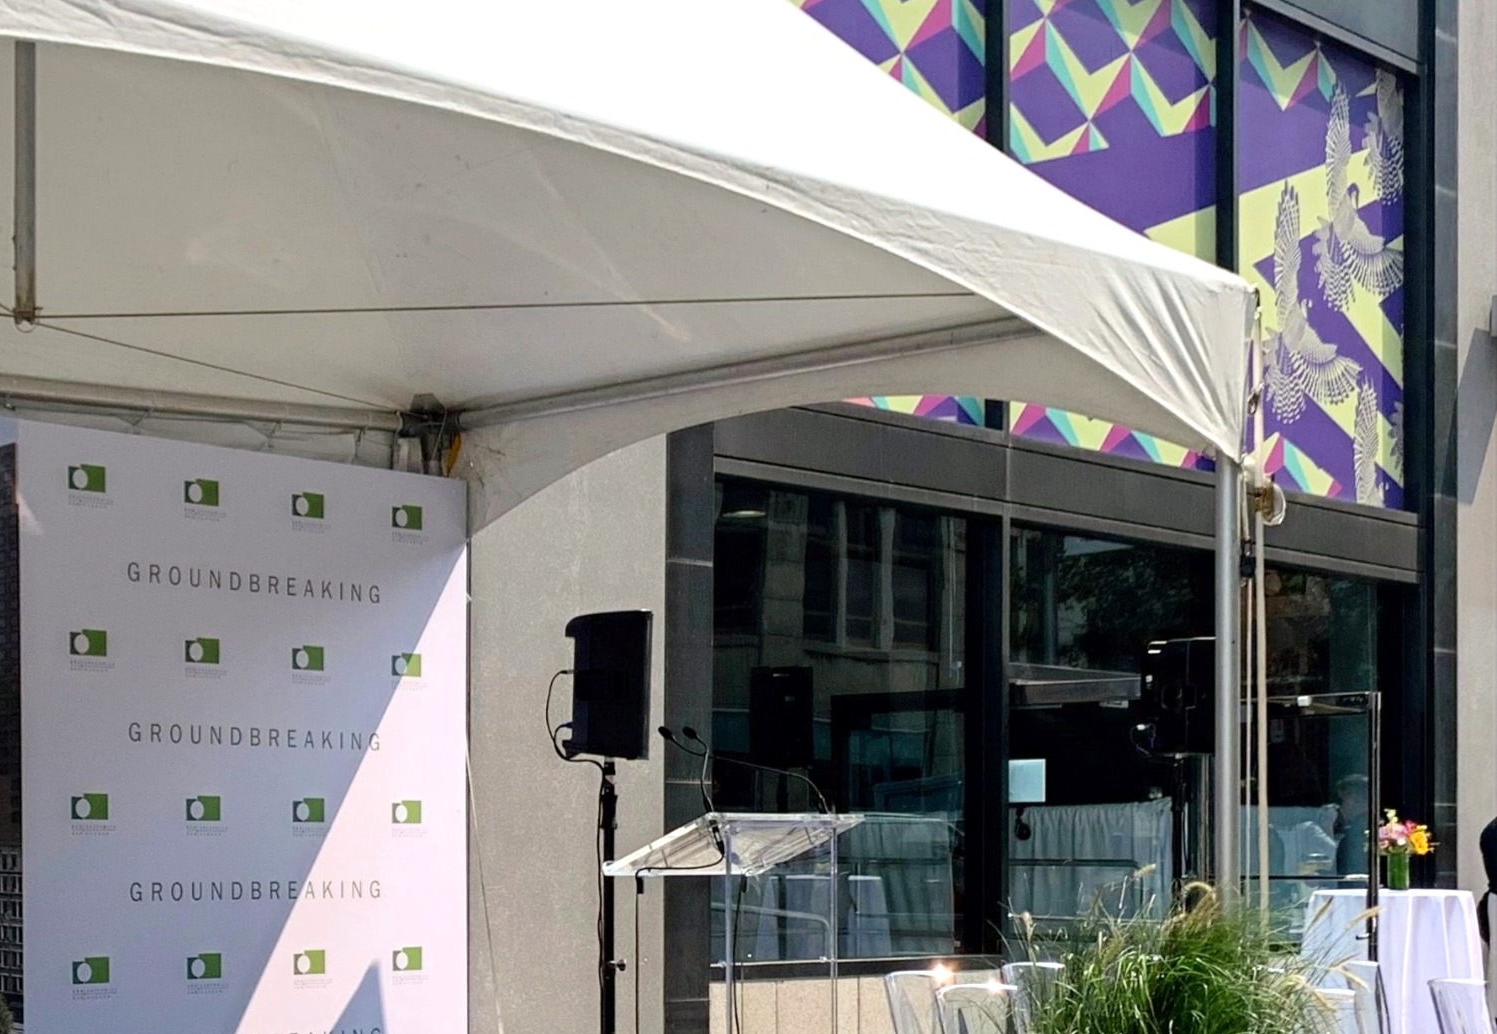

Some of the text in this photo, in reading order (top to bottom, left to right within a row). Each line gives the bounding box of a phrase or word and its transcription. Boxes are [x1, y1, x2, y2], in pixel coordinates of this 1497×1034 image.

[127, 561, 382, 604] GROUNDBREAKING
[128, 721, 382, 752] GROUNDBREAKING
[129, 879, 383, 904] GROUNDBREAKING
